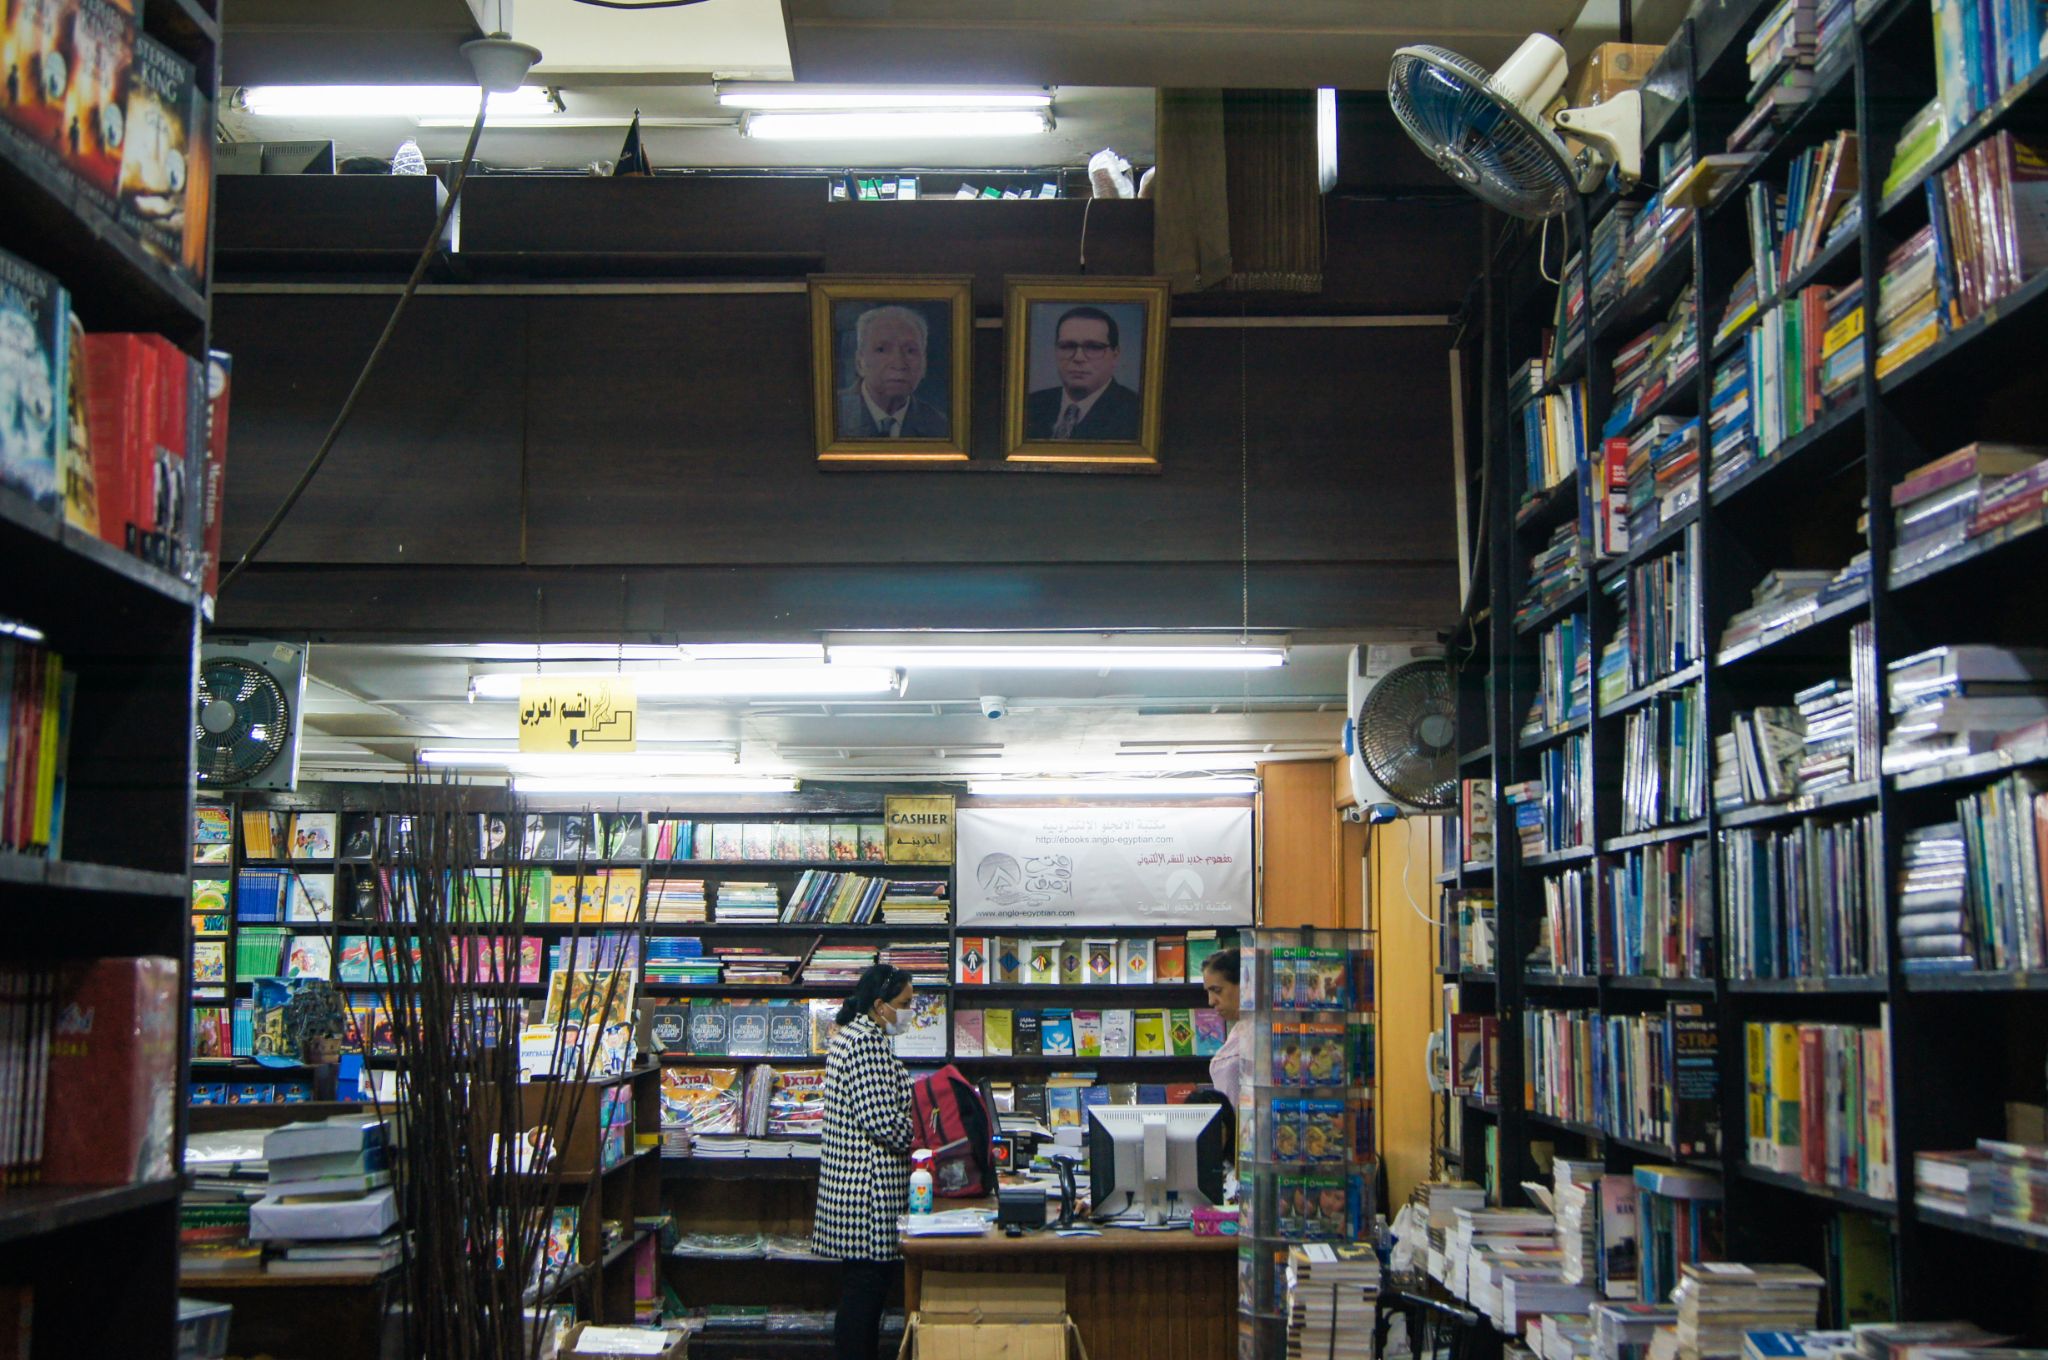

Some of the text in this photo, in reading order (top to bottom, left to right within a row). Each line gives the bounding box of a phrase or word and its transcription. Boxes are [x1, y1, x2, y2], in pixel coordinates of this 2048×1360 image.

[136, 37, 185, 84] STEPHEN
[141, 61, 177, 103] KING
[891, 813, 948, 825] CASHIER
[1035, 836, 1174, 845] http://ebooks.anglo-egyptian.com
[975, 909, 1076, 919] www.anglo-egyptian.com
